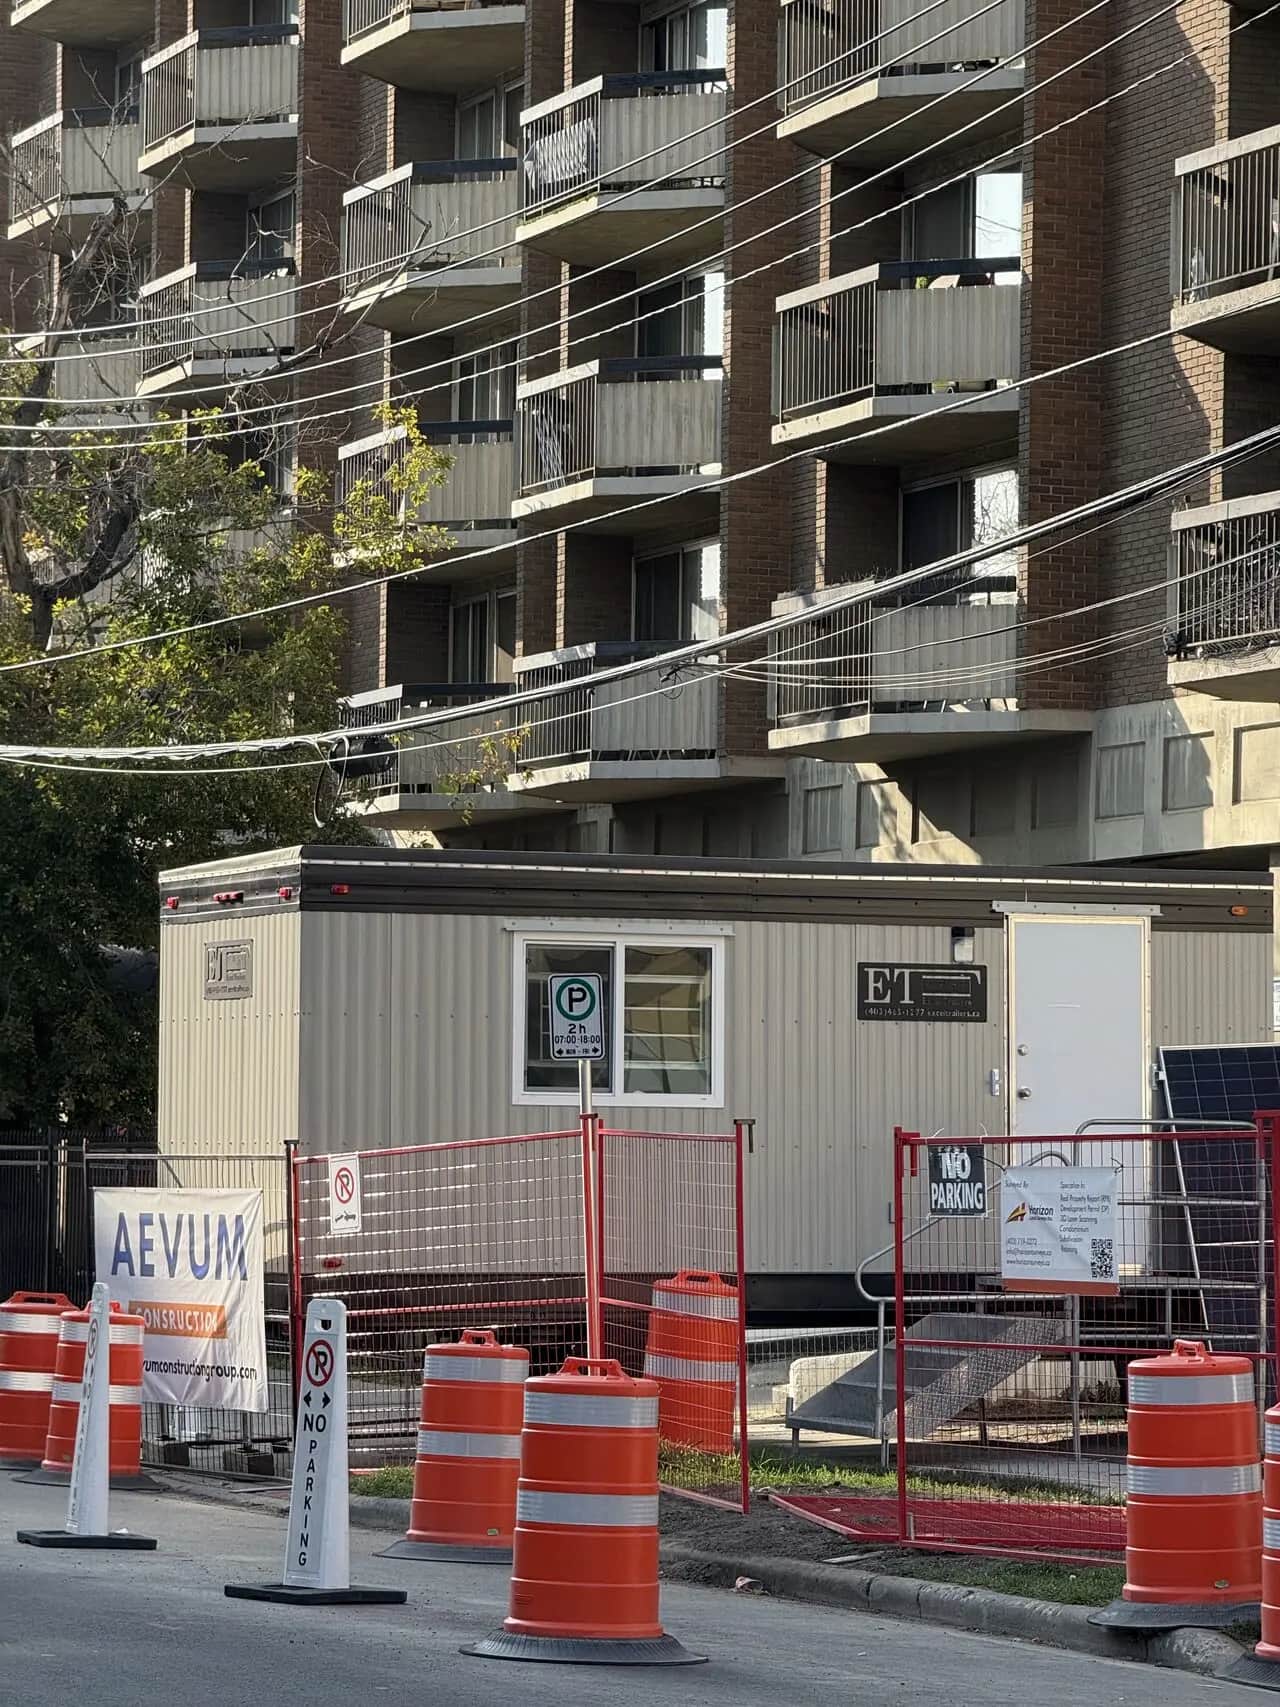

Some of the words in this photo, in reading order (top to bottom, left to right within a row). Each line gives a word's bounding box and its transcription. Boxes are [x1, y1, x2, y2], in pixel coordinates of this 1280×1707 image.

[568, 987, 587, 1013] P
[941, 1152, 972, 1179] NO
[931, 1182, 984, 1209] PARKING
[1029, 1204, 1054, 1216] Horizon
[112, 1211, 248, 1281] AEVUM
[303, 1413, 327, 1433] NO
[298, 1439, 318, 1567] PARKING
